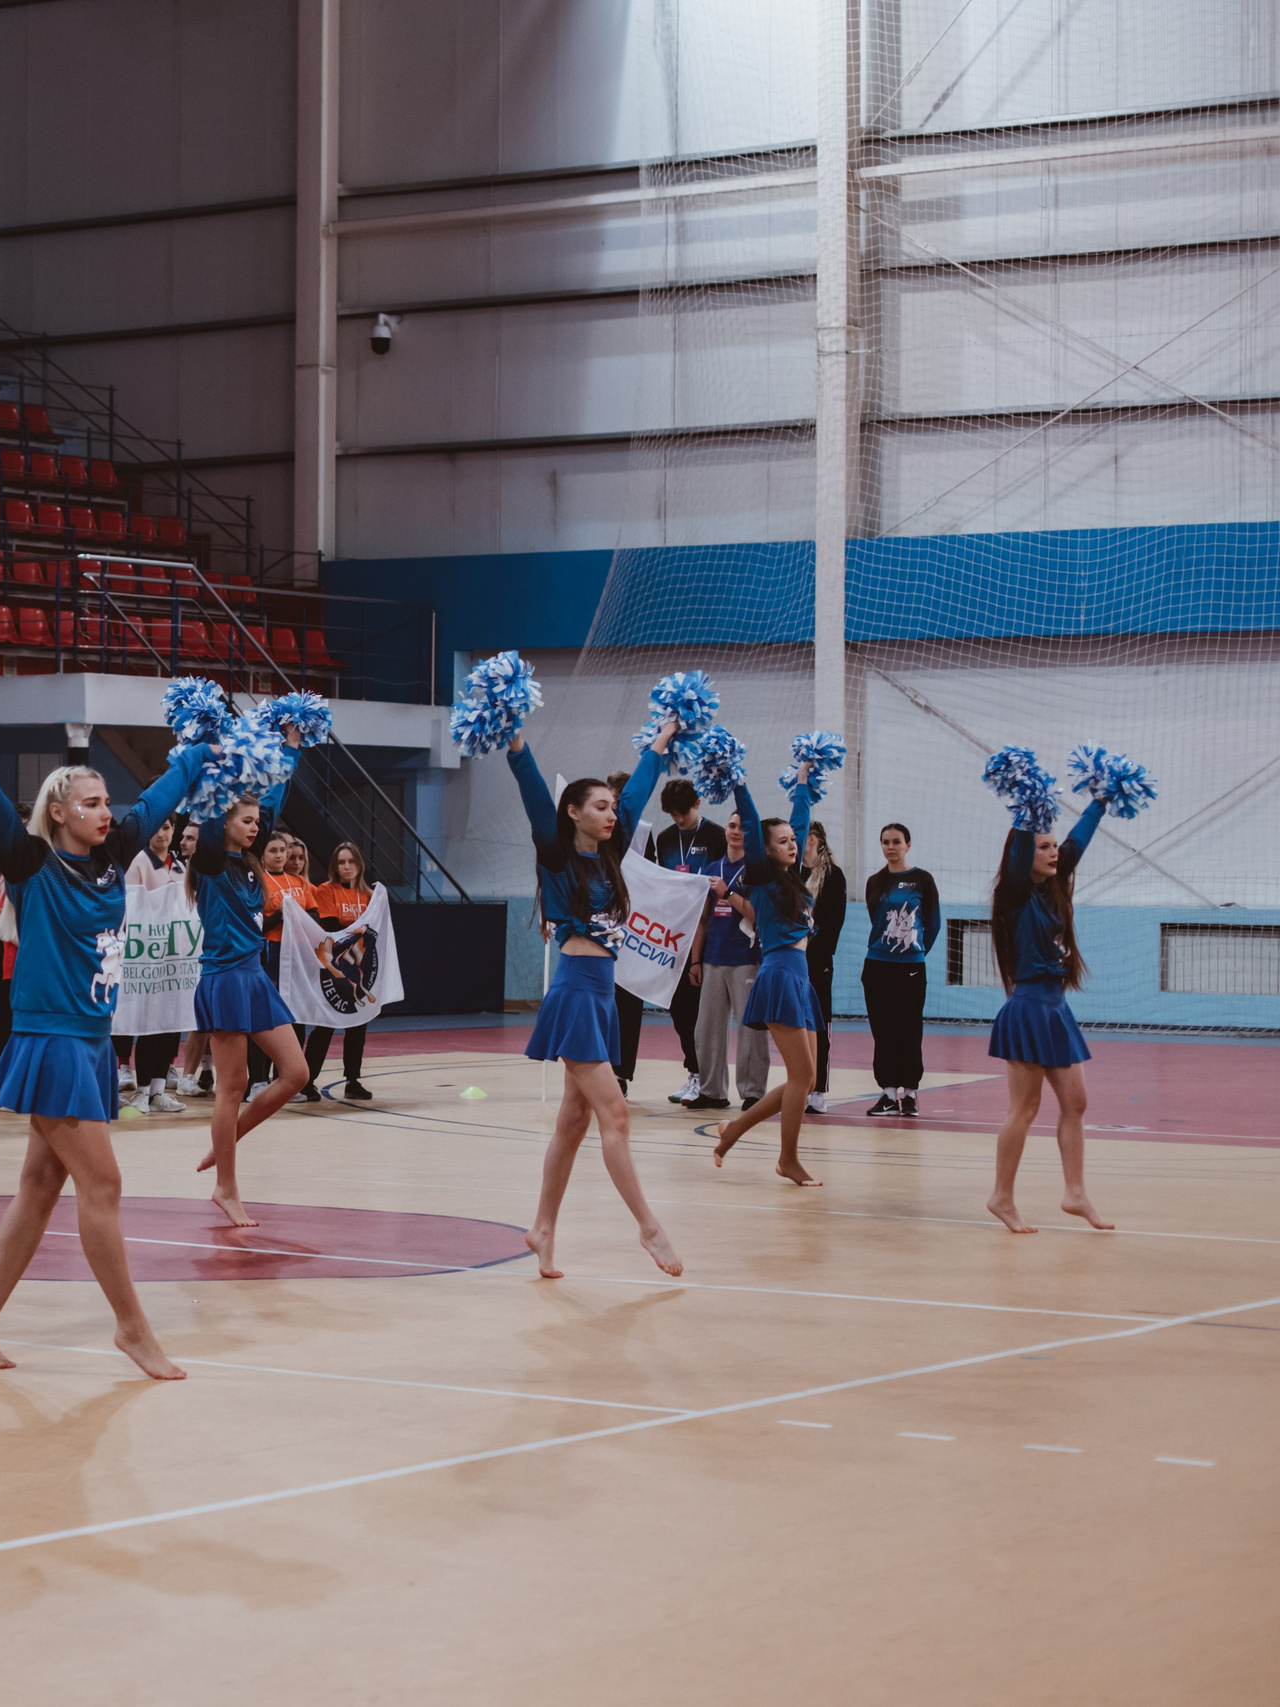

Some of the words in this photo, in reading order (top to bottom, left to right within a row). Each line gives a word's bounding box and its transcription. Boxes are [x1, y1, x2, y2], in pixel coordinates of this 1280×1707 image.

[624, 911, 686, 953] ССК
[180, 961, 202, 975] STAT
[322, 978, 349, 1012] ПЕГАС
